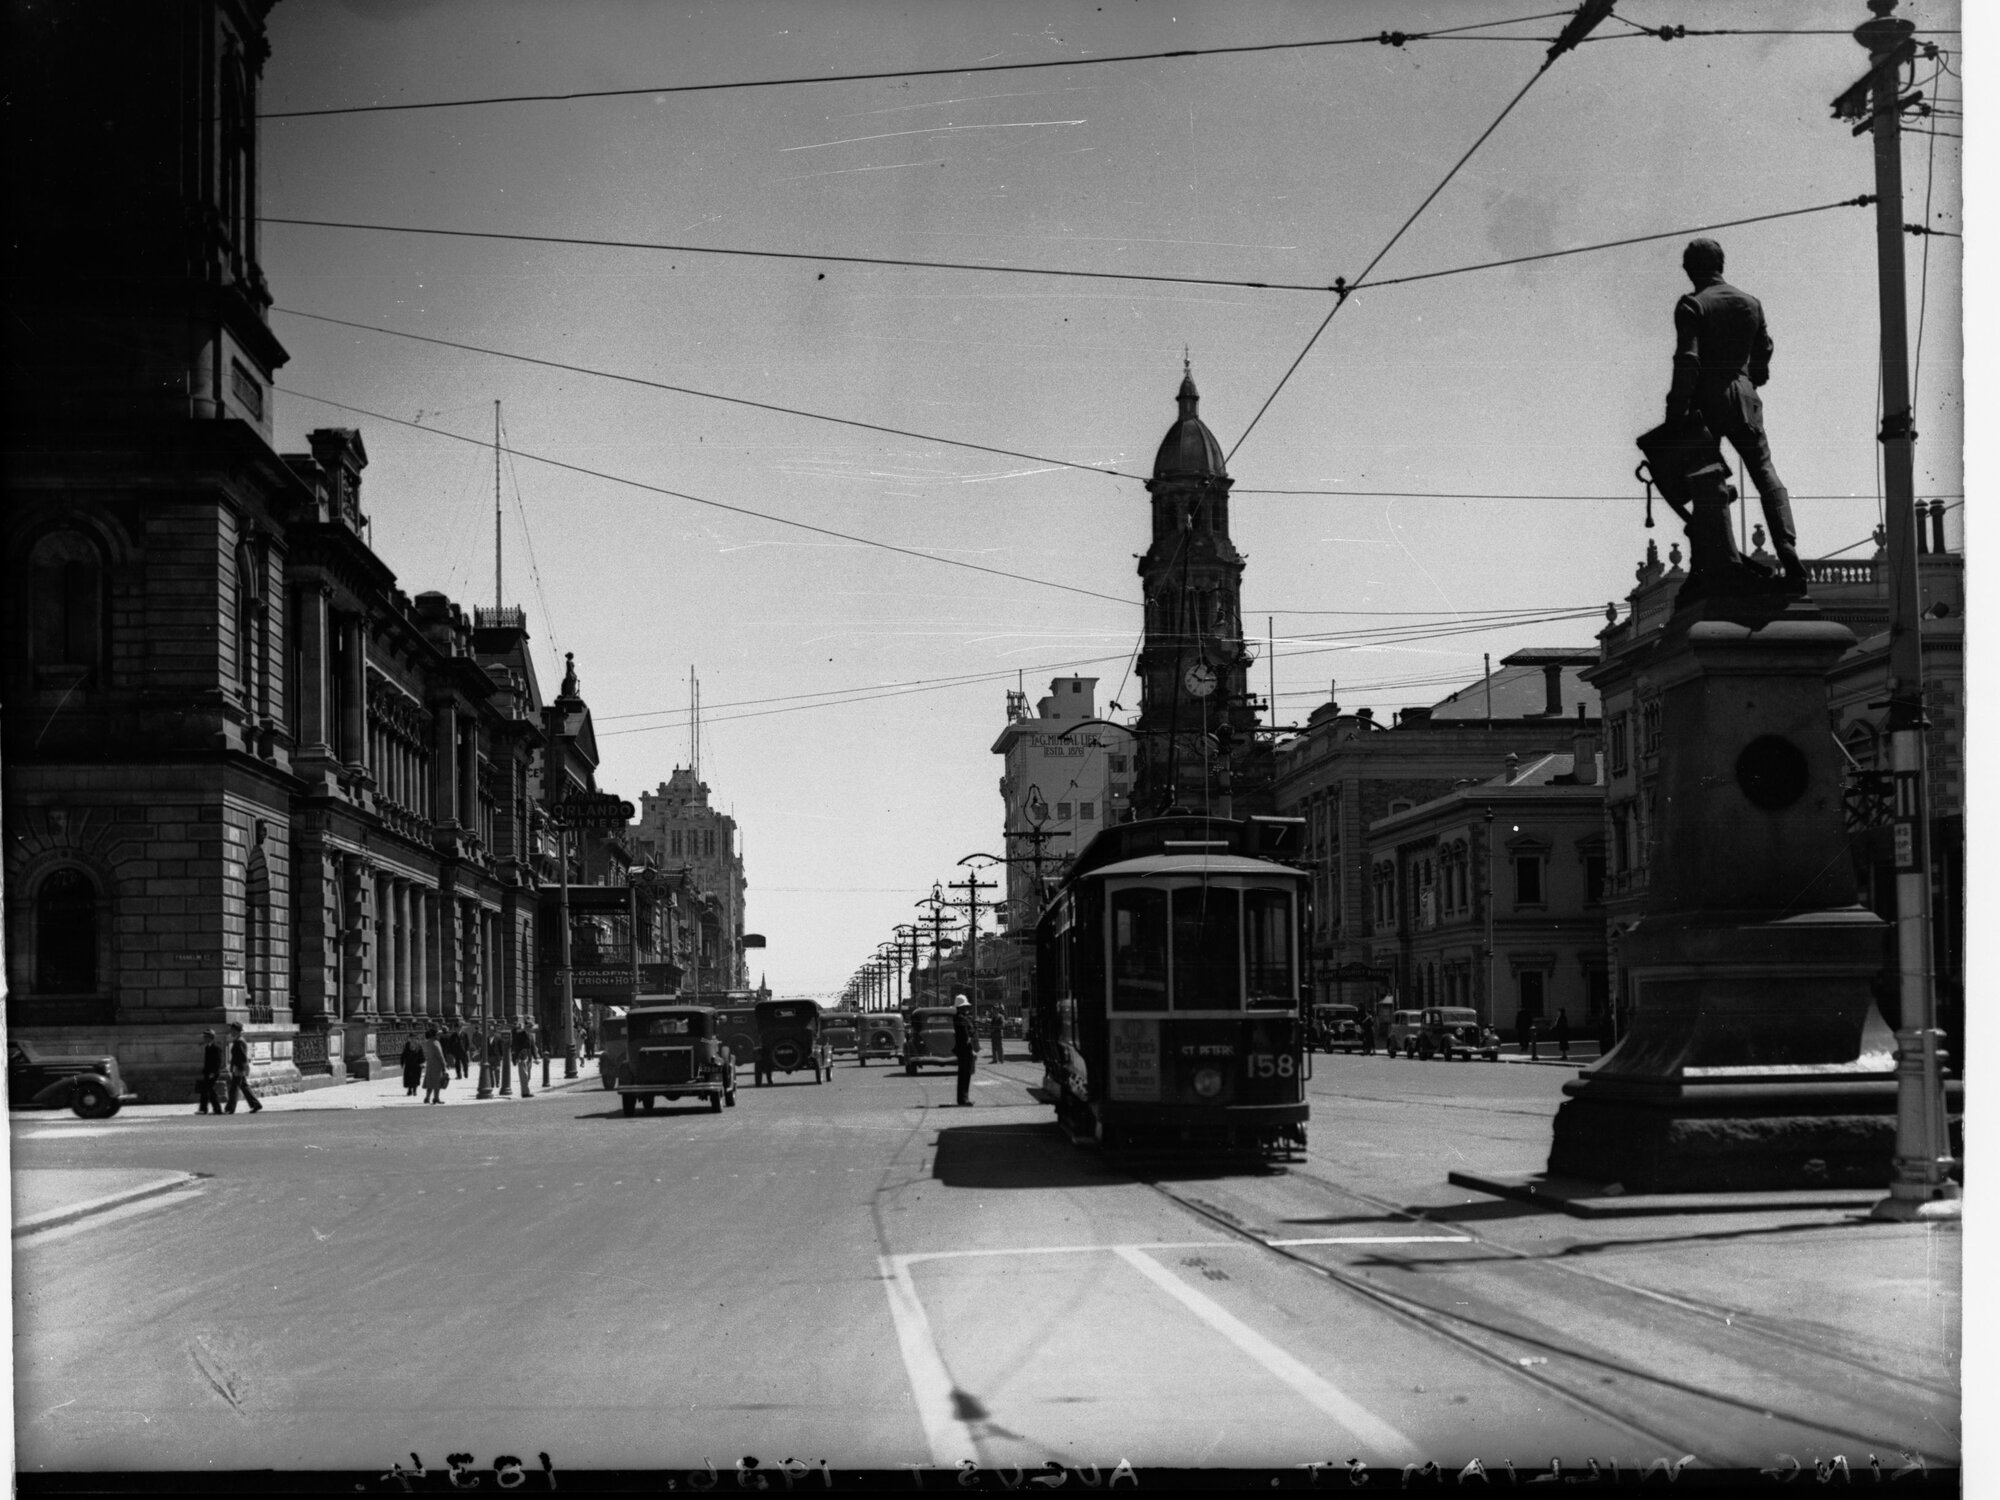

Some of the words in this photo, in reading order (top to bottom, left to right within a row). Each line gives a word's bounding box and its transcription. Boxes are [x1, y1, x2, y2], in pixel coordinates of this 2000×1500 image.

[552, 803, 632, 818] ORLANDO
[565, 818, 620, 829] WINES
[1268, 825, 1287, 846] 7
[554, 976, 609, 985] CTERION
[1199, 1045, 1235, 1056] PETERS
[1247, 1053, 1294, 1078] 158
